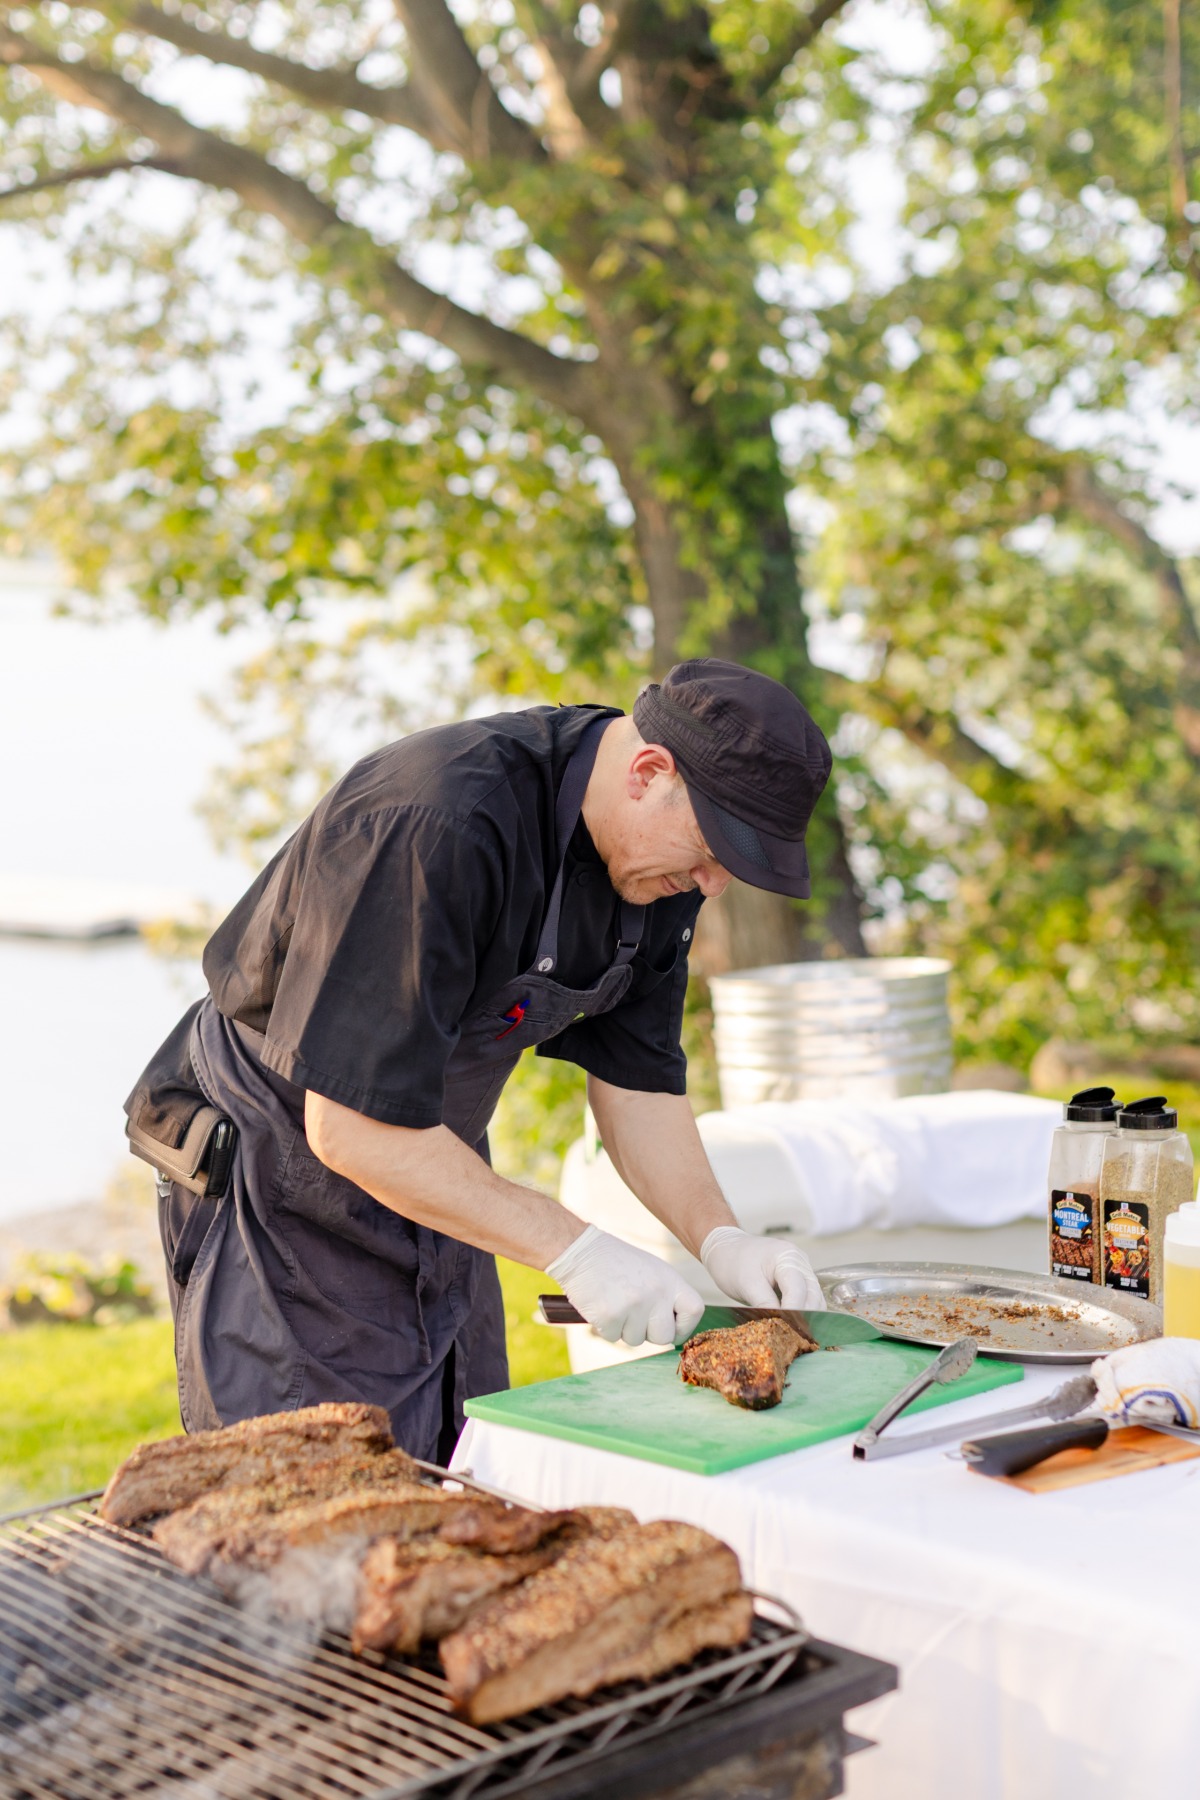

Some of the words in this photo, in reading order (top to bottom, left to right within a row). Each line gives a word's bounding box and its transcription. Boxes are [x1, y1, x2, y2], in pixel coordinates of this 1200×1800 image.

[1054, 1209, 1089, 1222] MONTREAL
[1123, 1212, 1139, 1221] Mates
[1106, 1222, 1146, 1235] VEGETABLE
